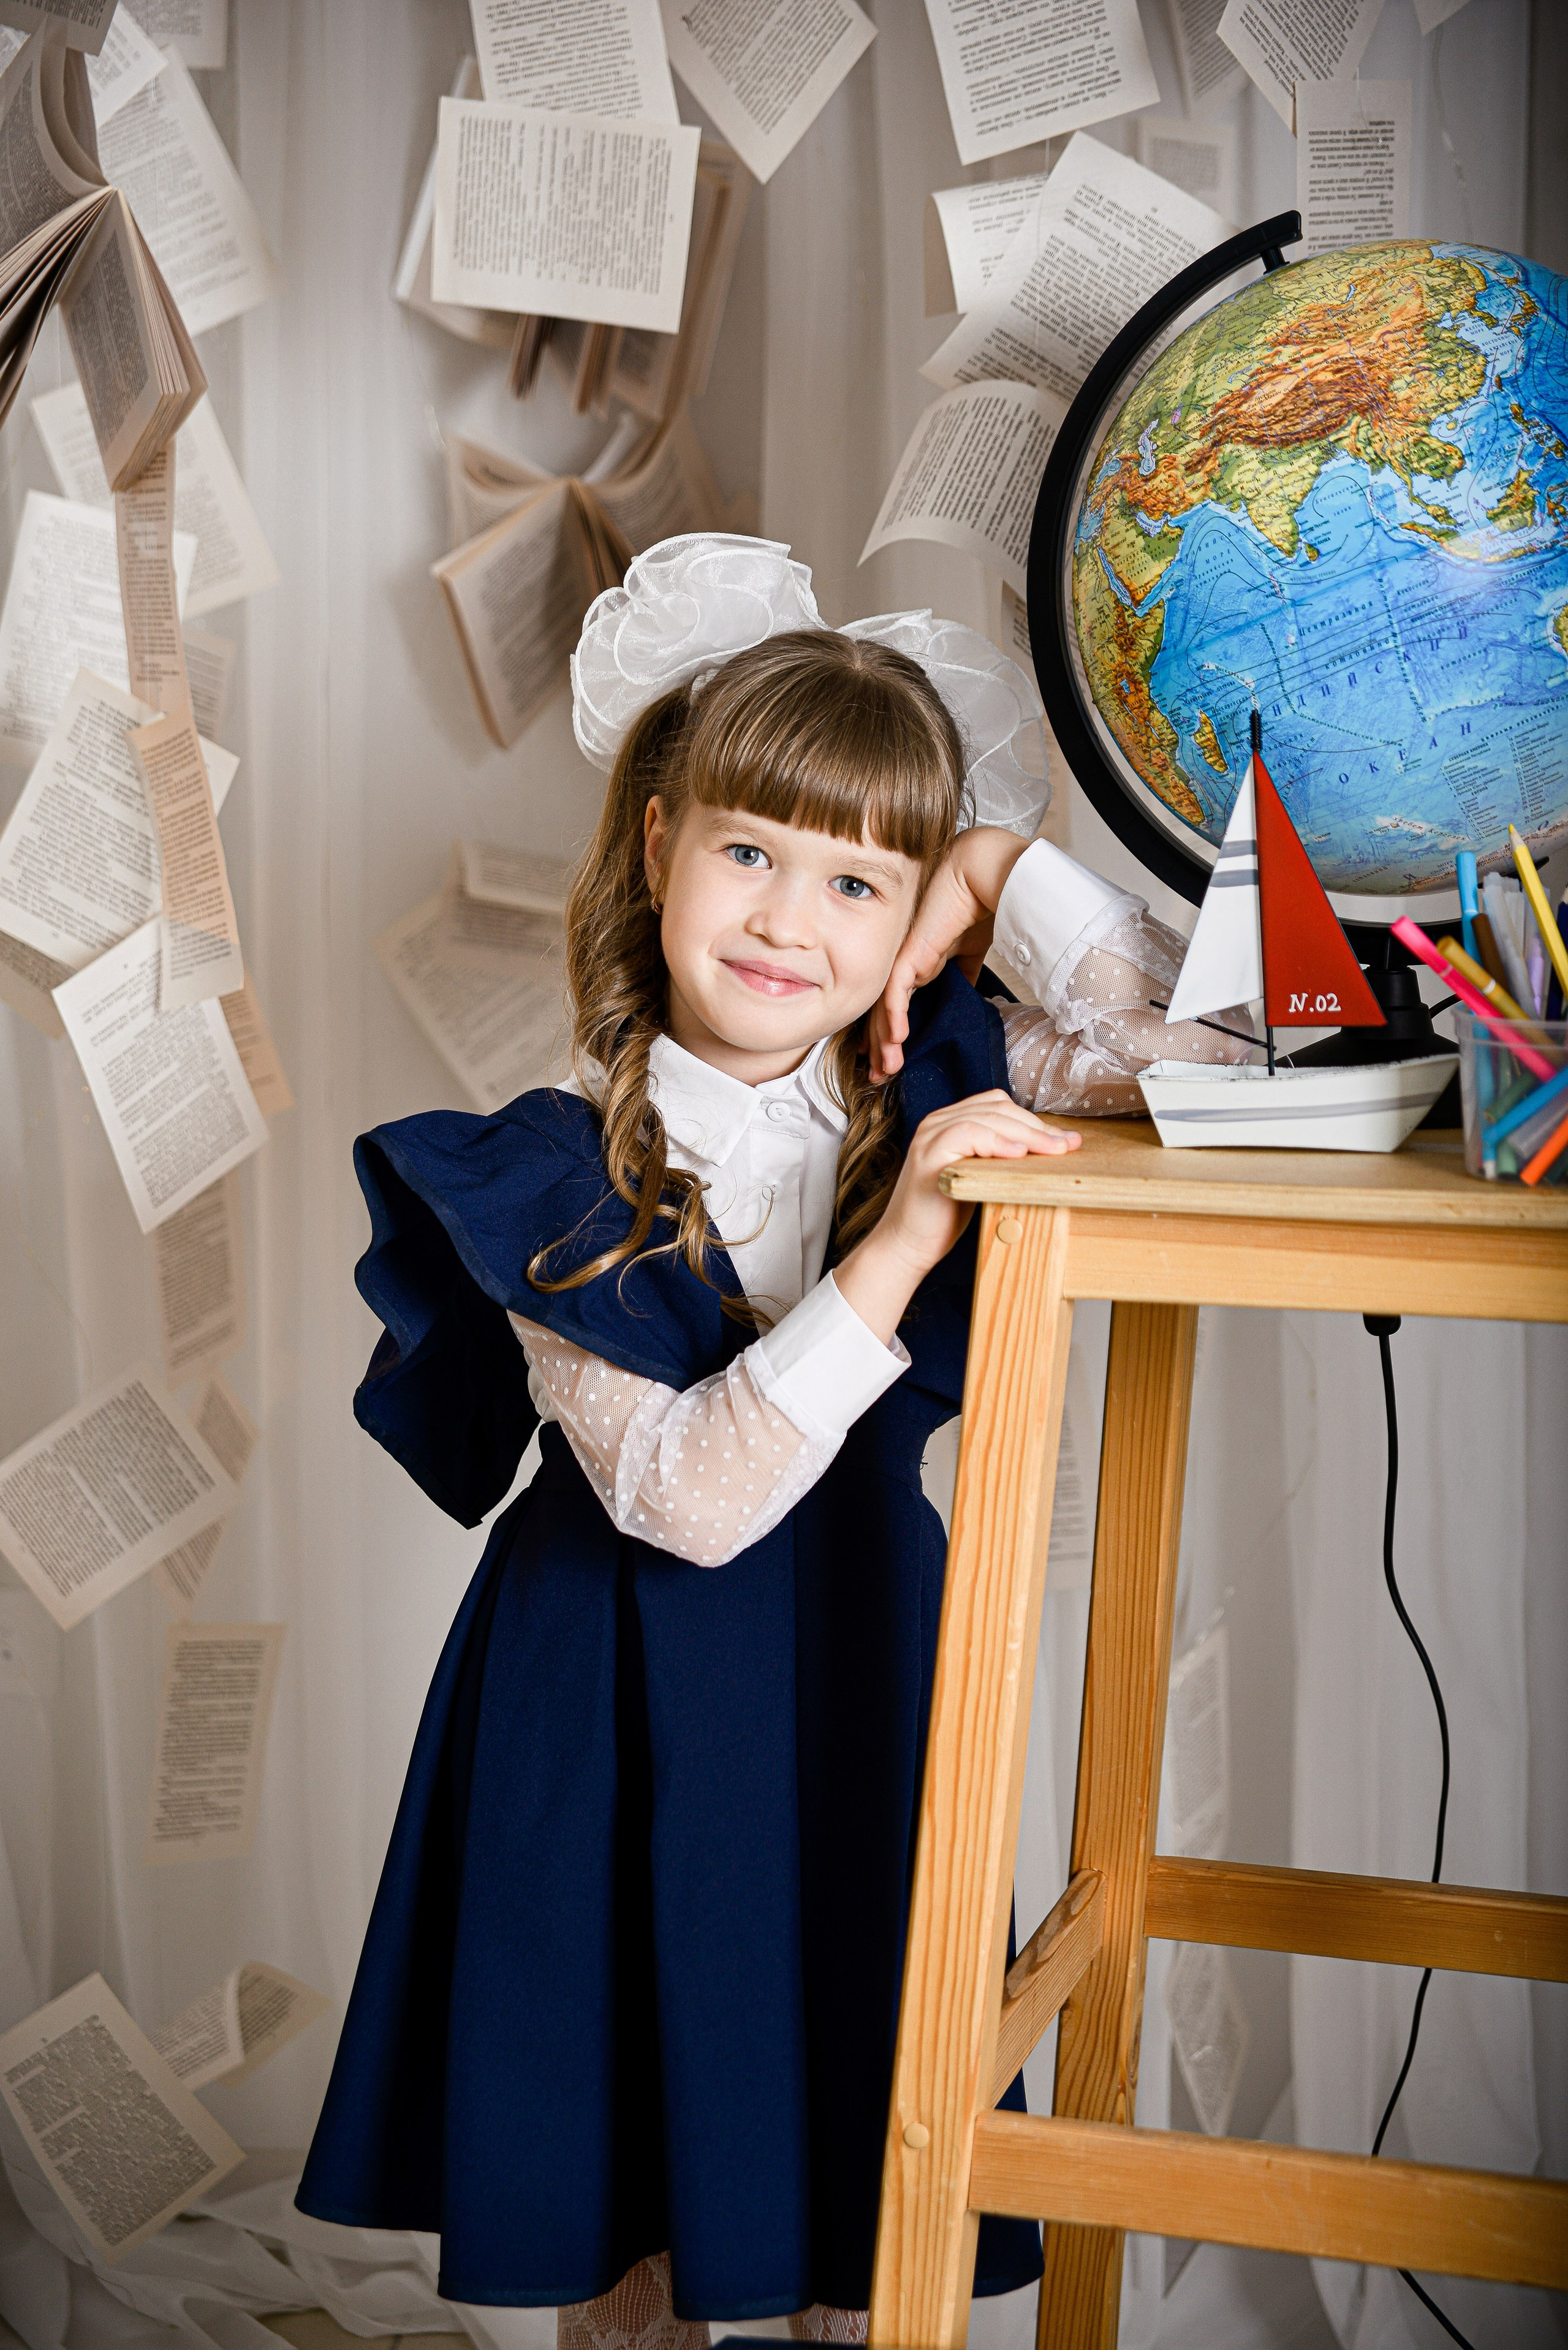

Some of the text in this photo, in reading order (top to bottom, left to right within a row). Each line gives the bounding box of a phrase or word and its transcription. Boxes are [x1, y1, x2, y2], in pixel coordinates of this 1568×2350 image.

[1299, 601, 1373, 636] Центральная
[1471, 785, 1488, 796] ЕВРОПА
[1289, 992, 1342, 1014] N.02
